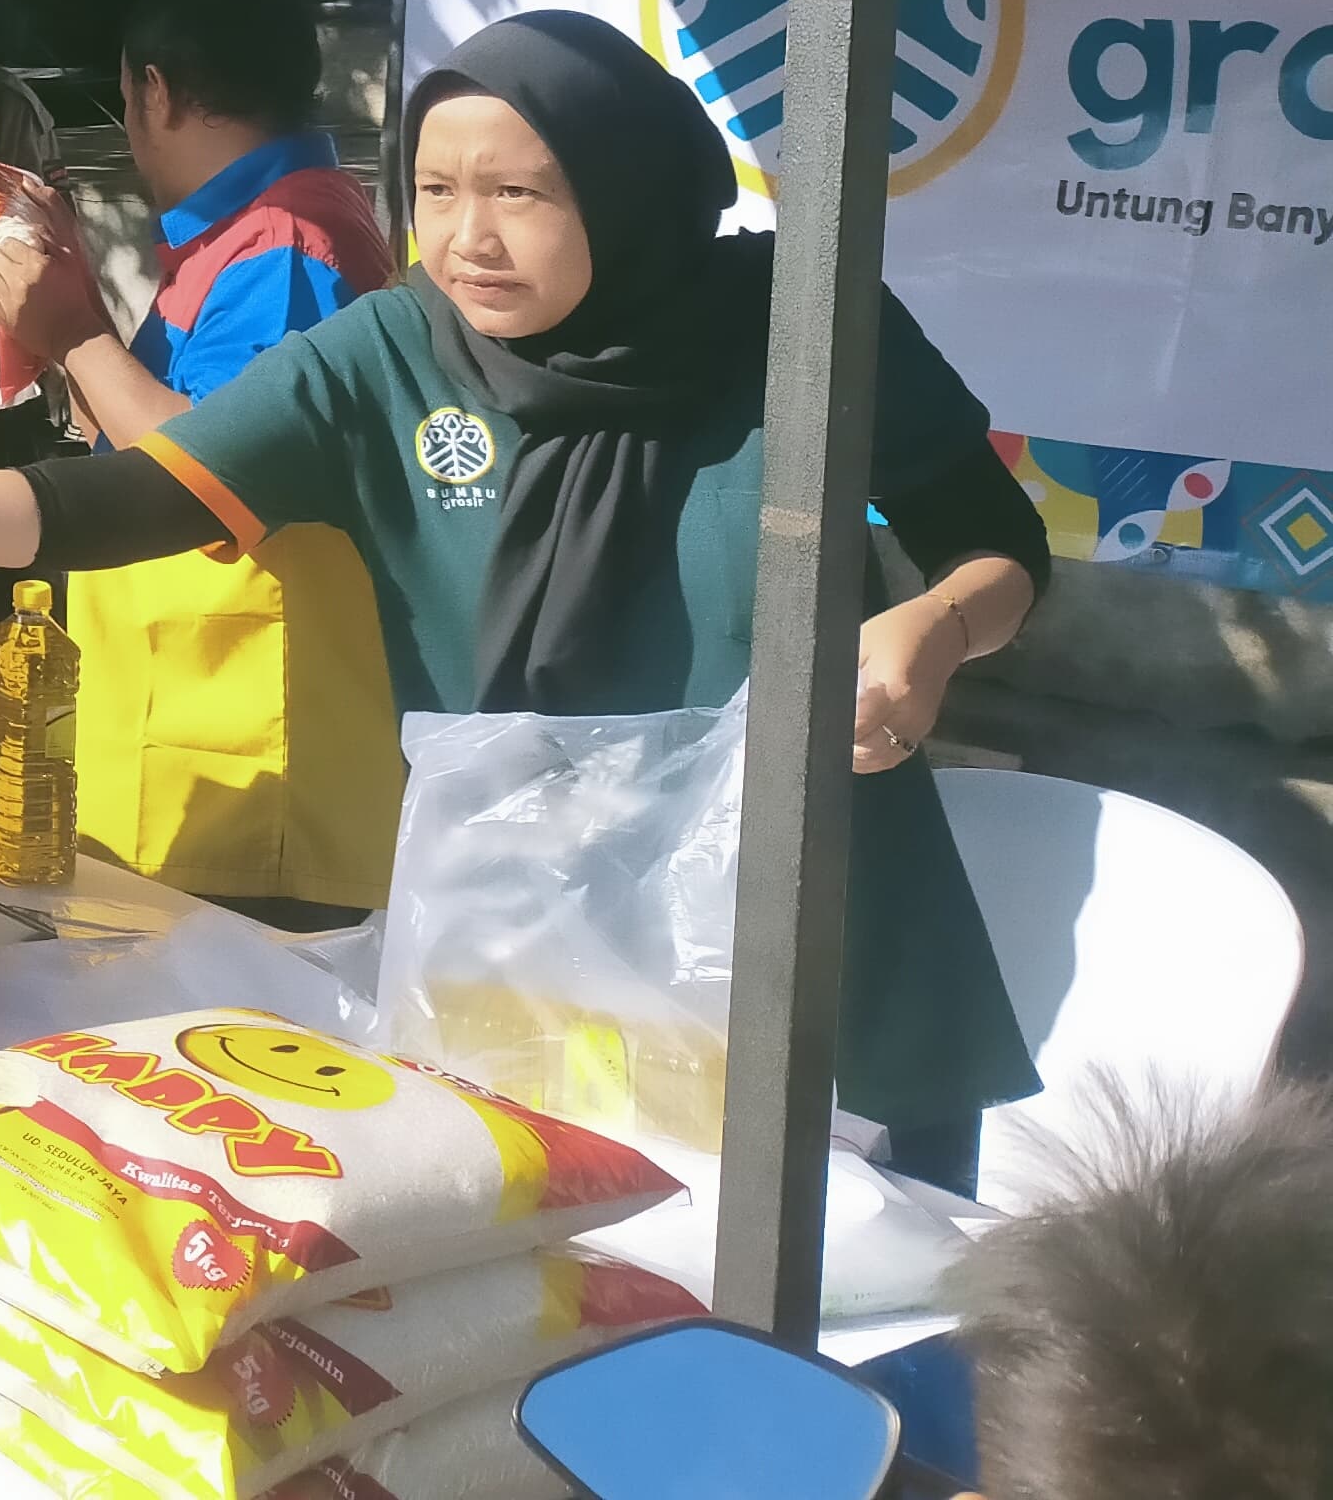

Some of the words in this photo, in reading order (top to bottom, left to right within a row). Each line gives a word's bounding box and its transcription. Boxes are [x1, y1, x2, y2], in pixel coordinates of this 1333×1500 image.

[1055, 179, 1214, 236] Untung
[1227, 192, 1333, 246] Bany
[441, 496, 485, 511] grosir
[21, 1031, 345, 1180] HAPPY
[22, 1132, 42, 1149] UD.
[44, 1144, 99, 1178] SEDULUR
[98, 1176, 129, 1206] JAYA
[44, 1158, 86, 1183] JEMBER
[121, 1161, 203, 1195] Kwalitas
[268, 1322, 345, 1385] erjamin
